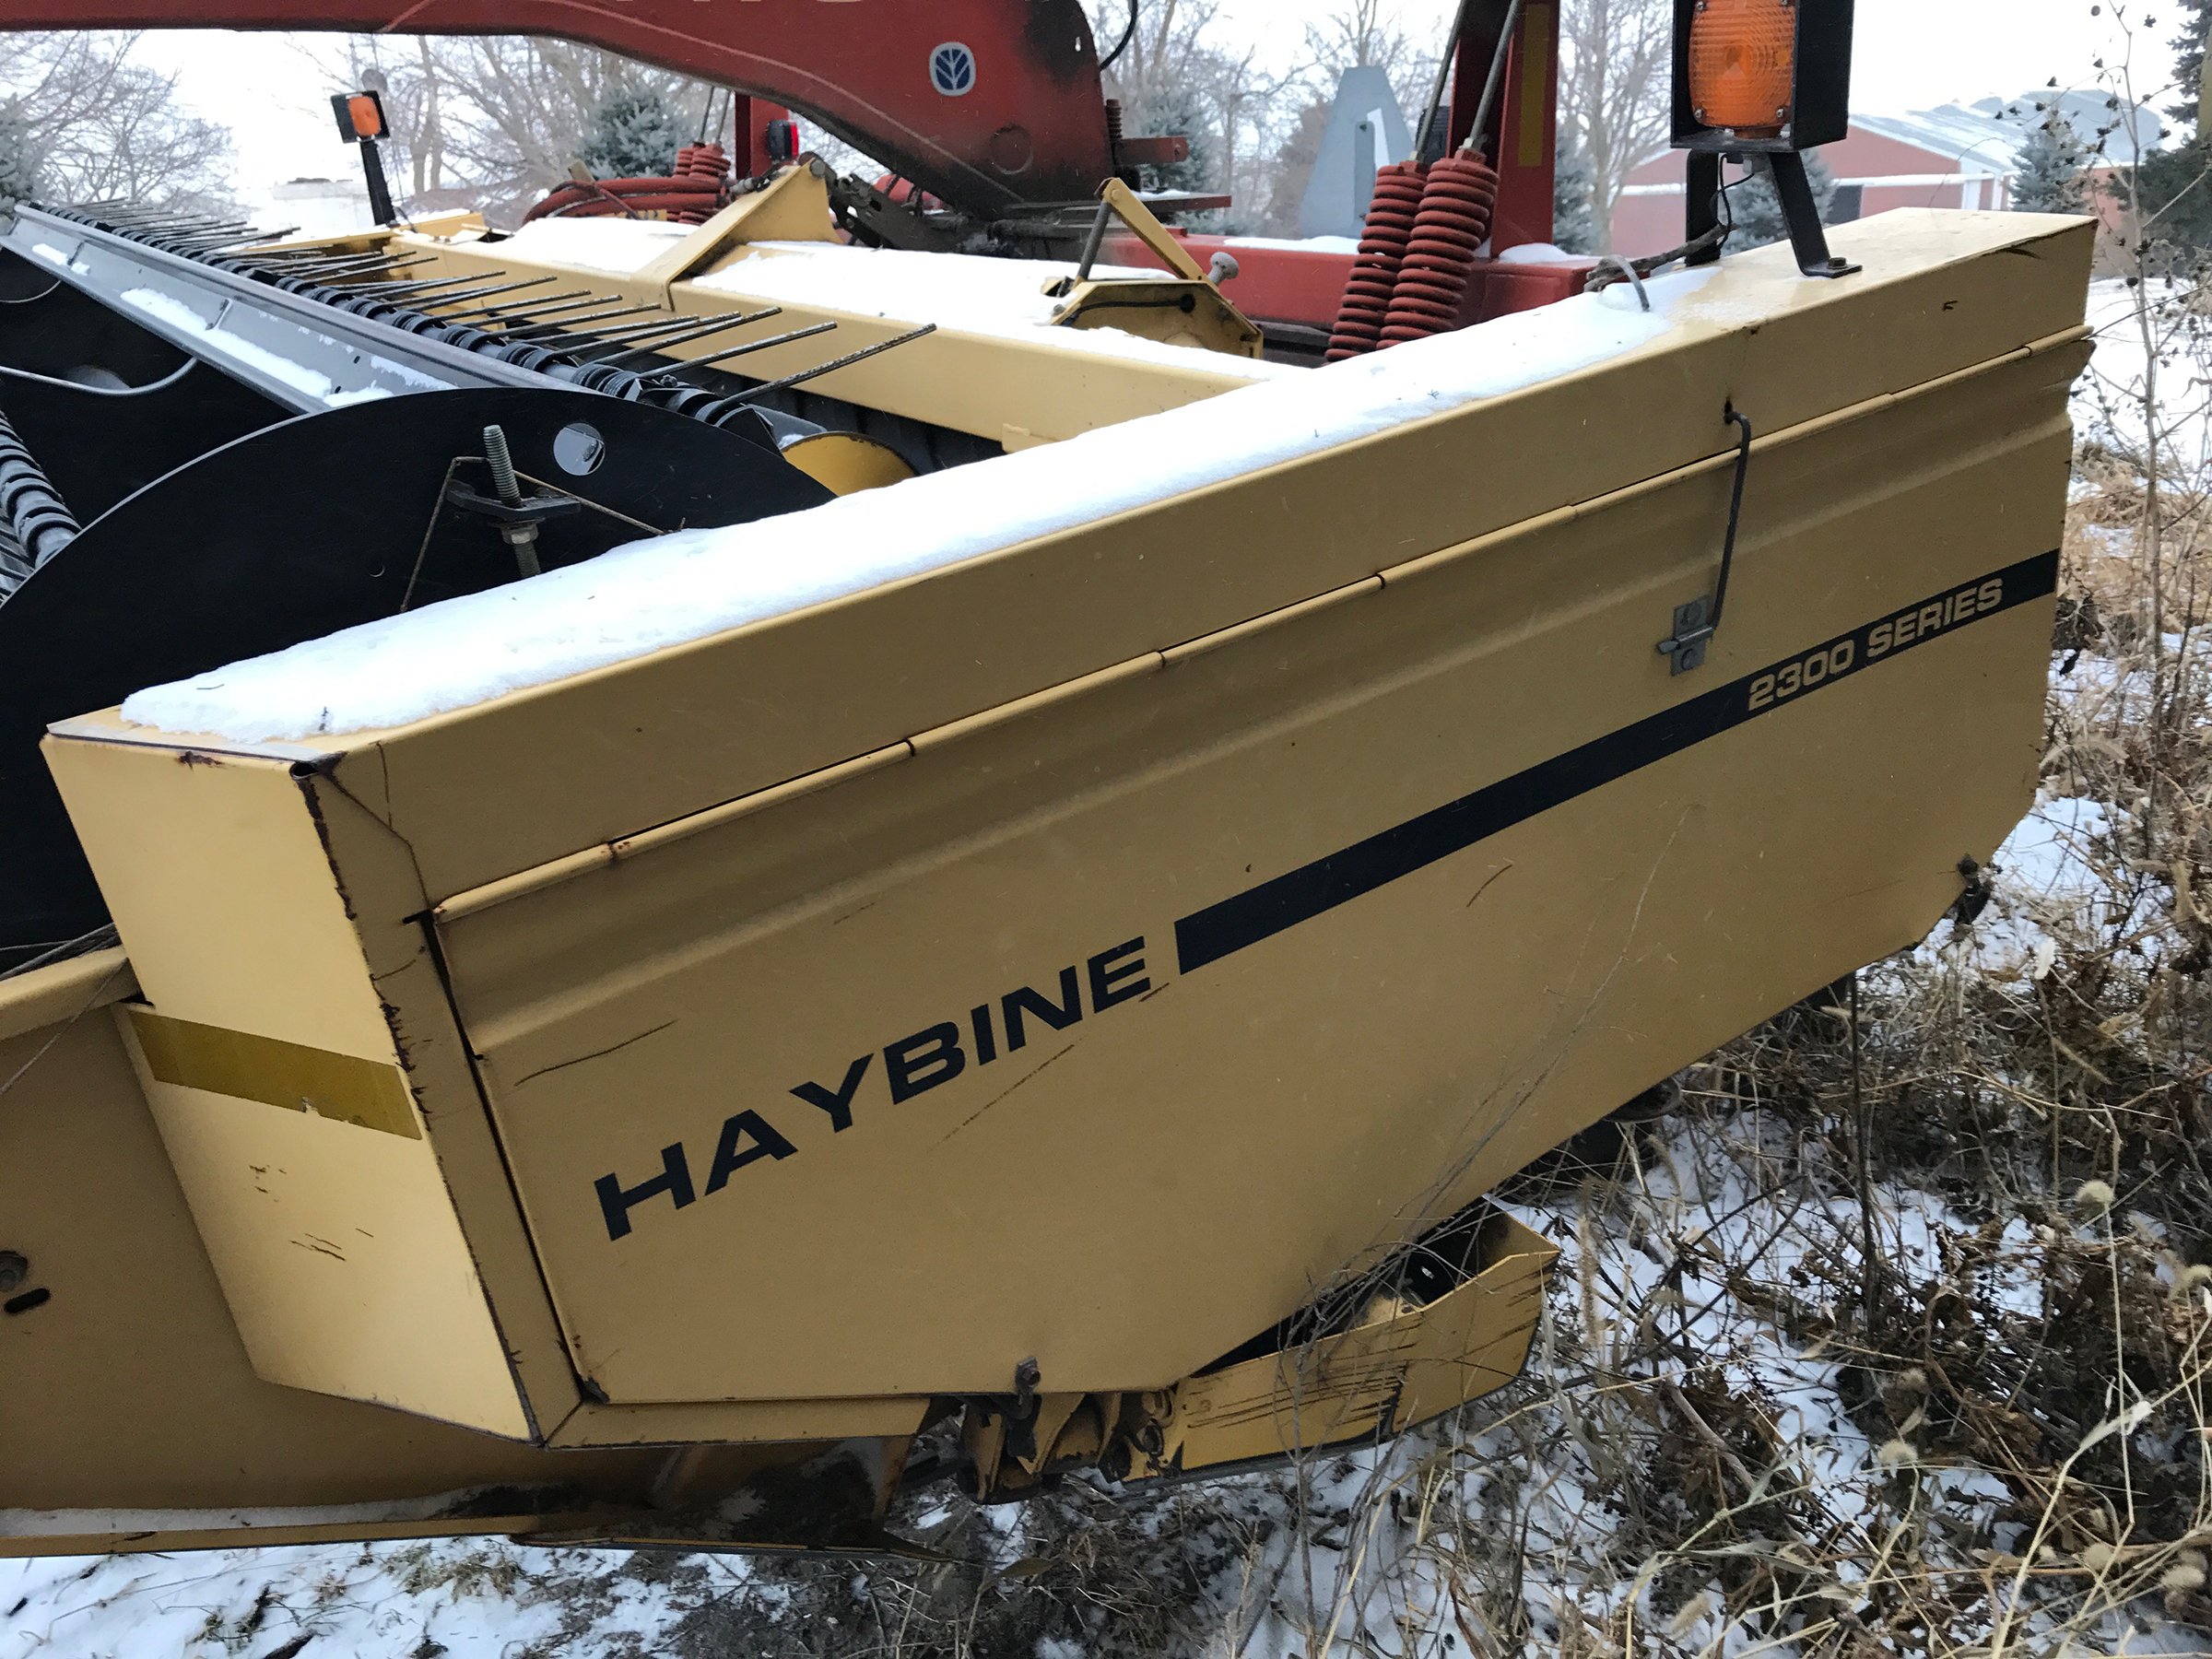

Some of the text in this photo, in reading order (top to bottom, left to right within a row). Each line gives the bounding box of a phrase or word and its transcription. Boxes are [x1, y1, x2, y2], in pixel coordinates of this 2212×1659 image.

[1748, 577, 2004, 711] 2300 SERIES
[594, 935, 1151, 1241] HAYBINE
